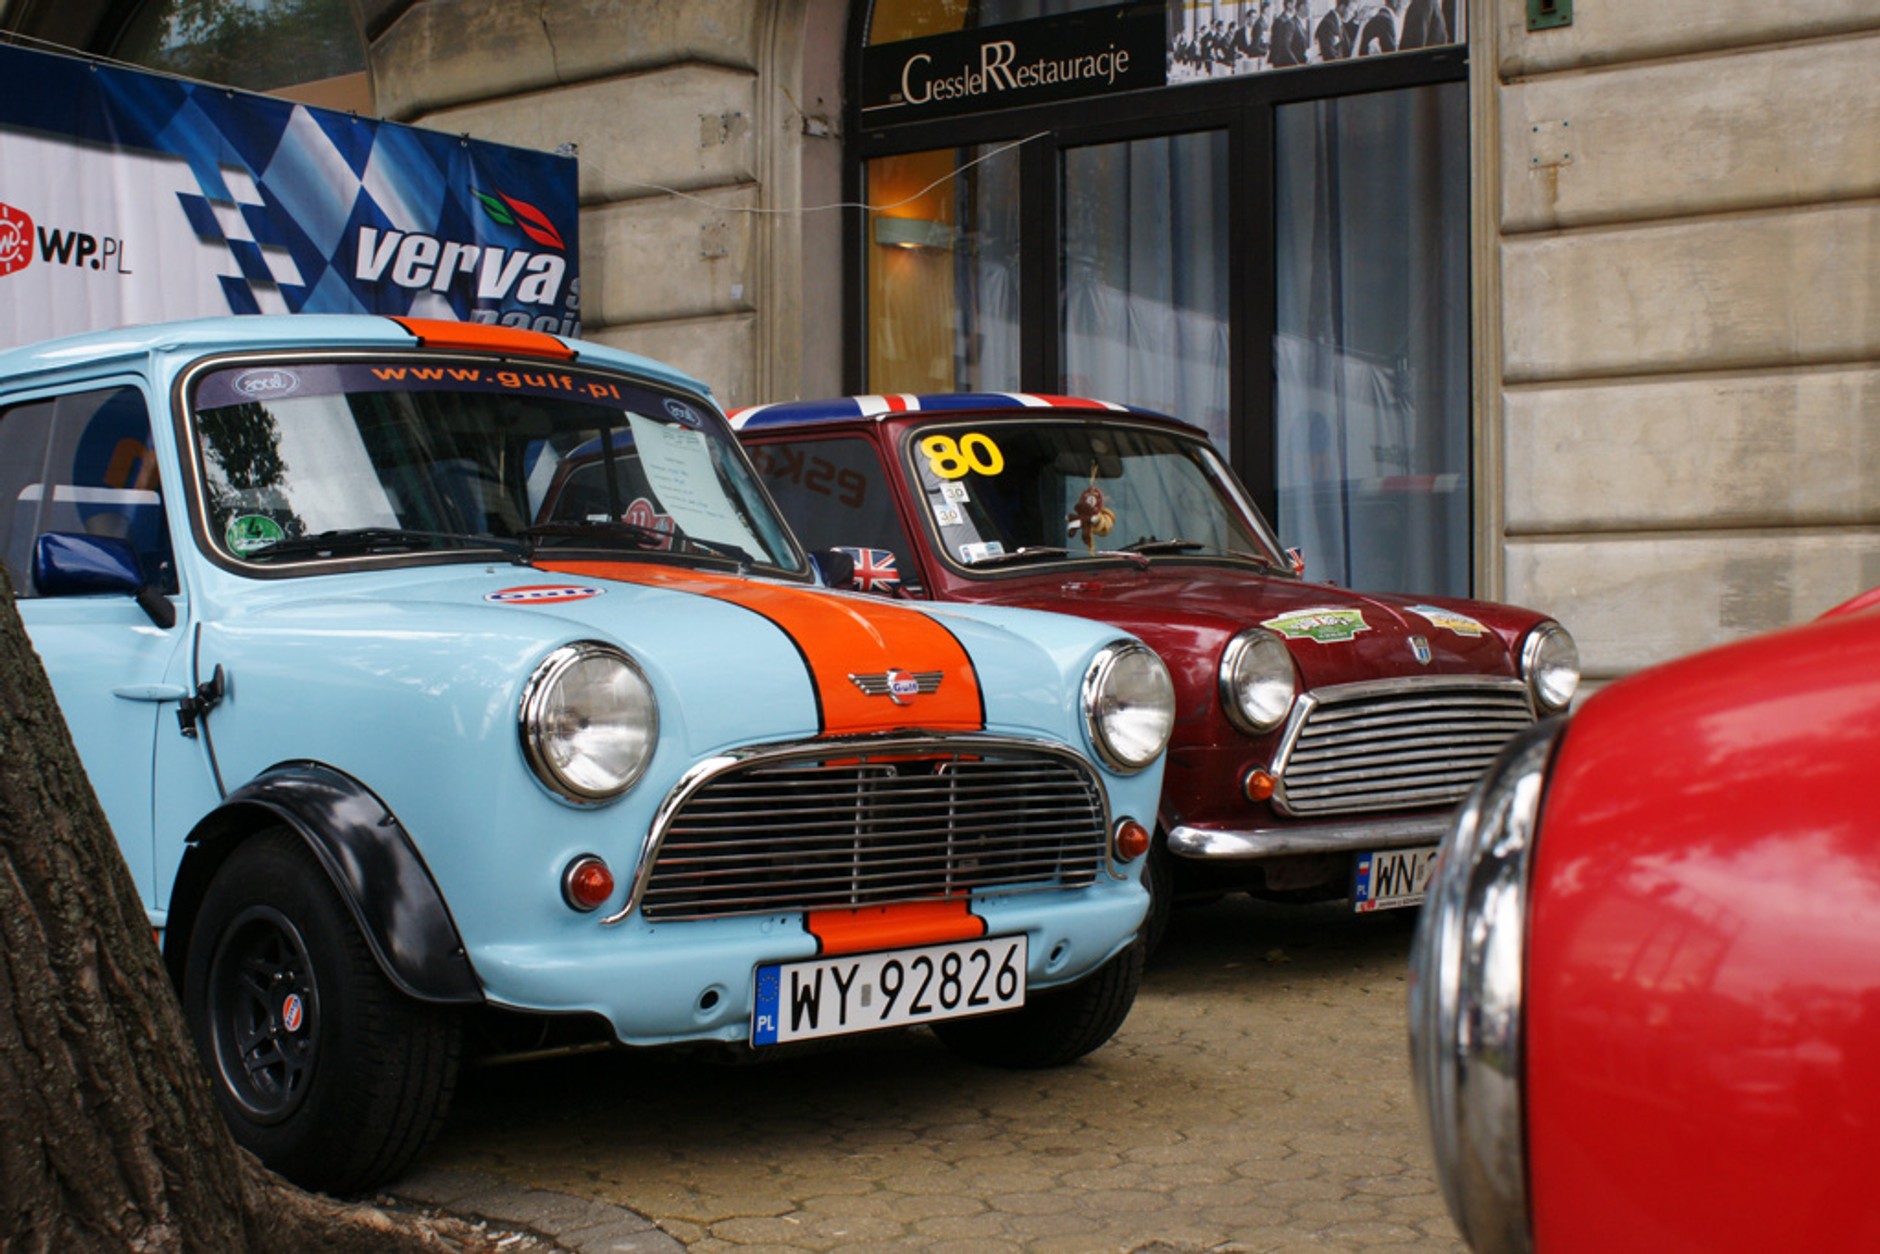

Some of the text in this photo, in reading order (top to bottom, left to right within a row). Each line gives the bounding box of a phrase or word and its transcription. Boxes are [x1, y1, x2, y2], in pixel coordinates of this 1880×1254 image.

[37, 225, 133, 274] WP.PL
[355, 226, 566, 306] verva
[371, 367, 620, 399] www.gulf.pl
[920, 432, 1004, 479] 80
[1375, 853, 1416, 897] WN
[791, 943, 1019, 1032] WY 92826
[757, 1014, 775, 1032] PL
